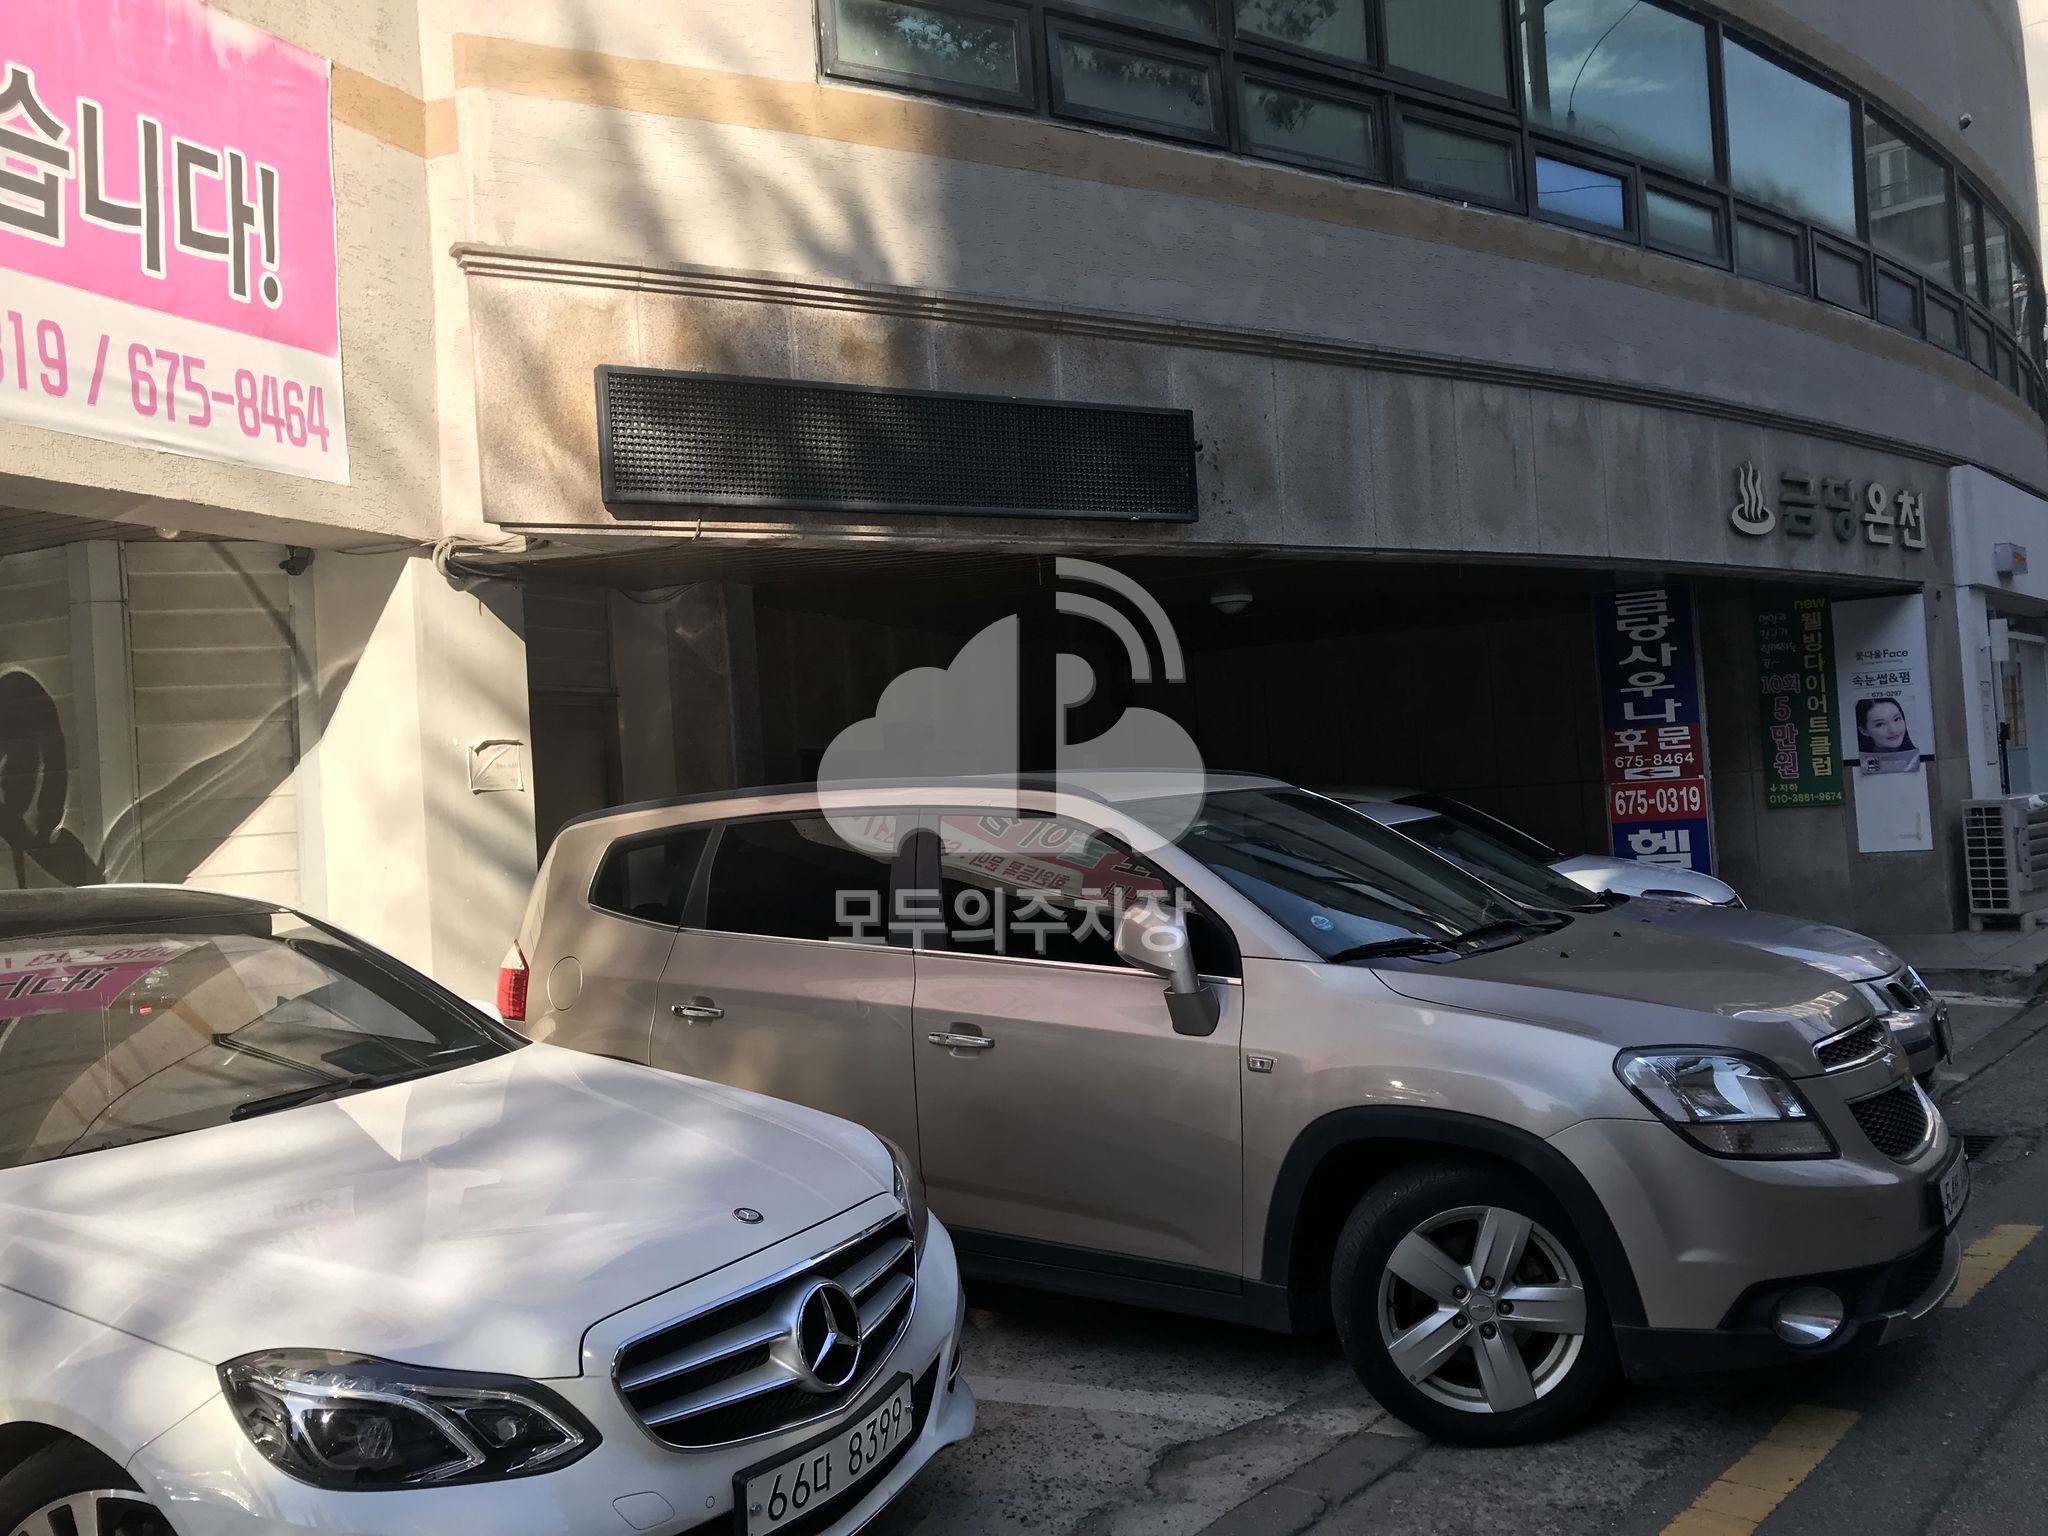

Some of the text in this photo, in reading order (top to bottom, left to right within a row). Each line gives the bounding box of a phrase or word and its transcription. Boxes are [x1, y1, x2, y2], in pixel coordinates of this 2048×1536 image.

[0, 62, 282, 308] 습니다!
[0, 310, 68, 397] 19
[128, 342, 330, 452] 675-8464
[1614, 589, 1682, 722] 금당사우나
[1800, 611, 1833, 777] 웰빙다이어트클럽
[1851, 671, 1911, 687] 속눈썹&펌
[1614, 751, 1695, 769] 675-8464
[1615, 786, 1701, 816] 675-0319
[767, 1396, 902, 1521] 66다 8399
